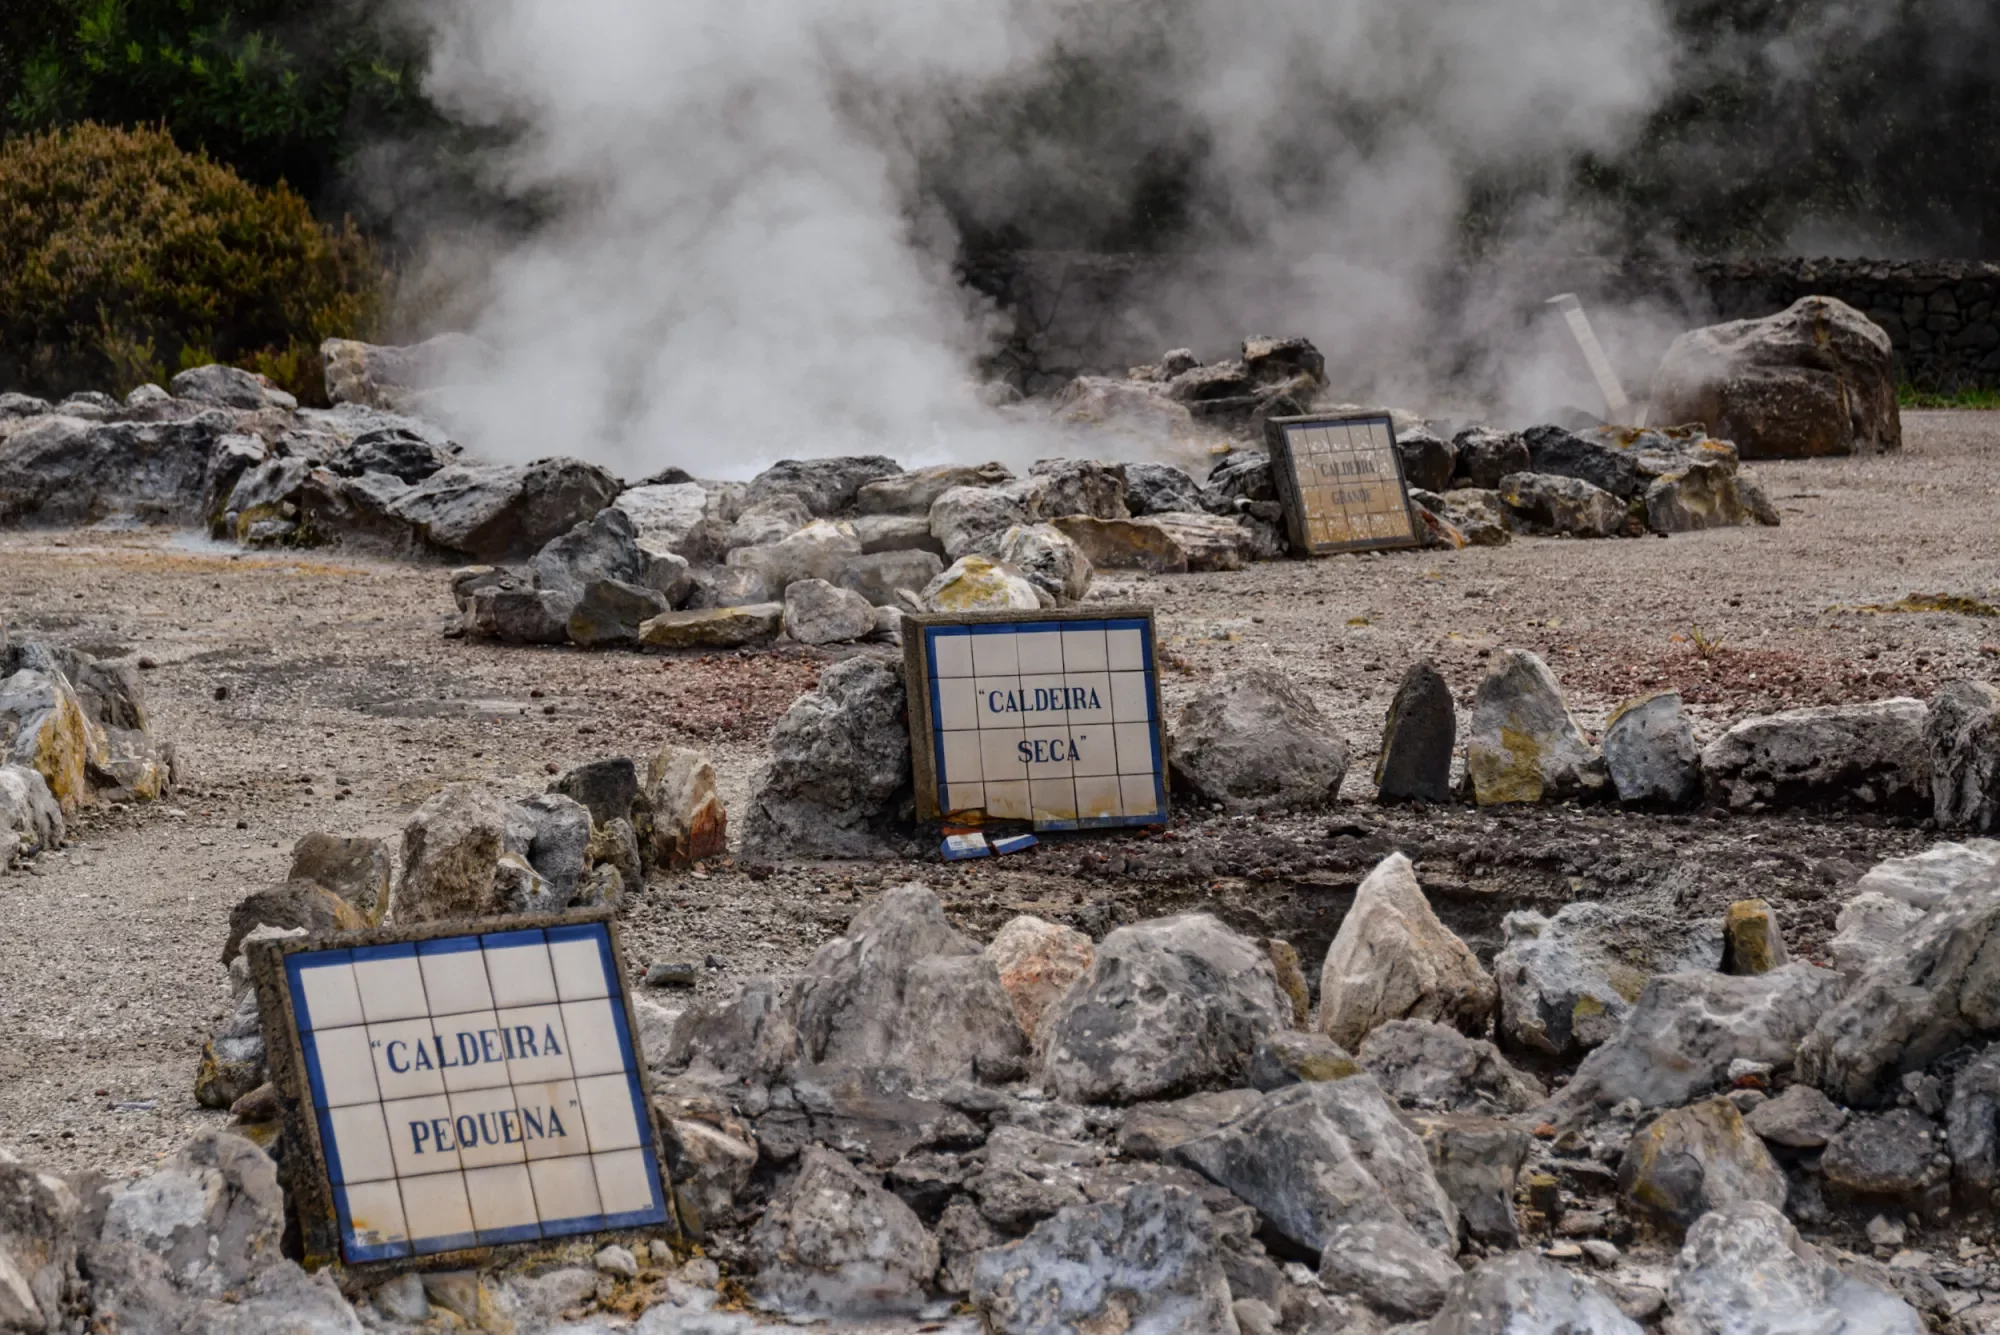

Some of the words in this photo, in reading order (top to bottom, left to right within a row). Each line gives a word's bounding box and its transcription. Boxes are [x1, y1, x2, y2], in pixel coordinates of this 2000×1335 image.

[978, 687, 1102, 713] “CALDEIRA
[1017, 735, 1087, 763] SECA”
[371, 1024, 563, 1073] “CALDEIRA
[408, 1100, 579, 1154] PEQUENA”
